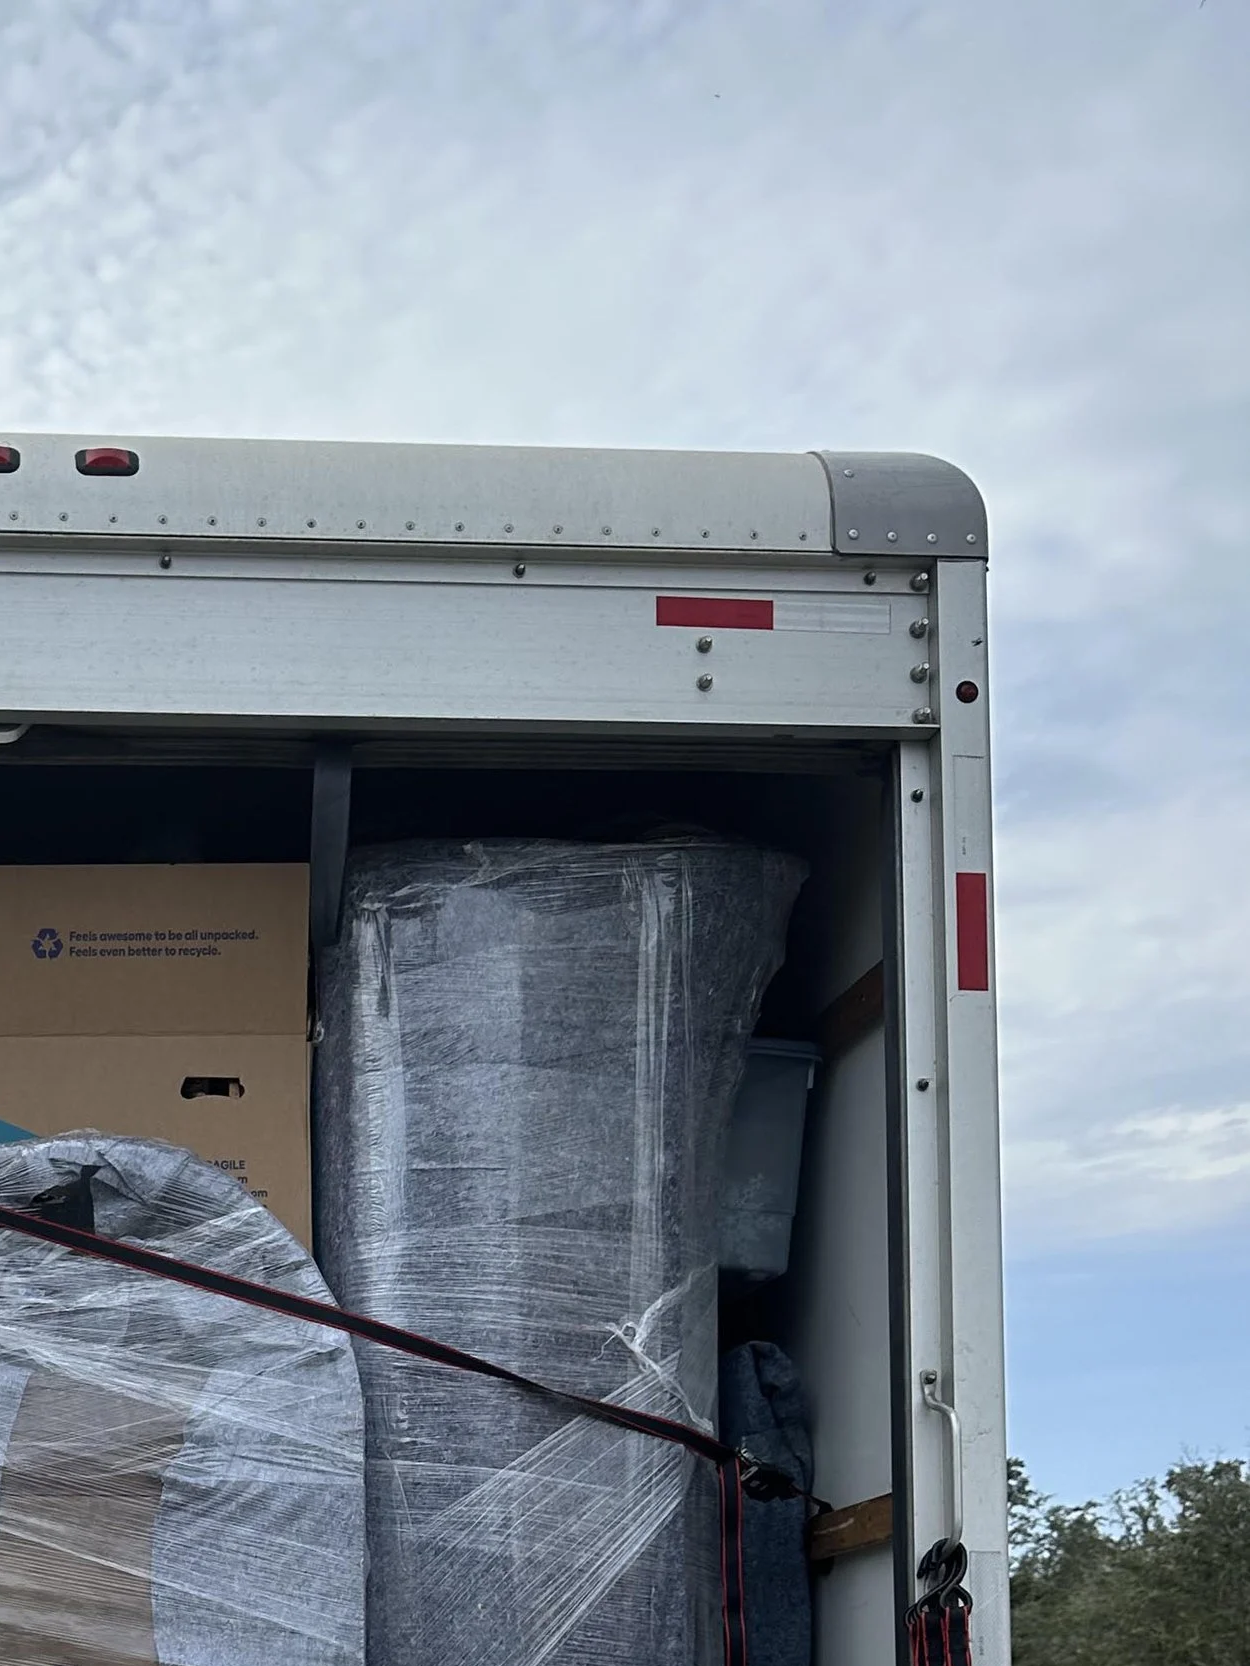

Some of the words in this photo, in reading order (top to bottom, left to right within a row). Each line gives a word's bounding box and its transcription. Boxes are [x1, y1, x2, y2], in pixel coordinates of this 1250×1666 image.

[69, 931, 98, 942] Feels
[99, 933, 150, 942] awesome
[154, 931, 166, 941] to
[168, 930, 182, 941] be
[184, 930, 198, 940] all
[200, 930, 259, 942] unpacked.
[69, 946, 98, 957] Feels
[99, 948, 126, 957] even
[128, 946, 163, 957] better
[164, 947, 176, 956] to
[178, 945, 222, 958] recycle.
